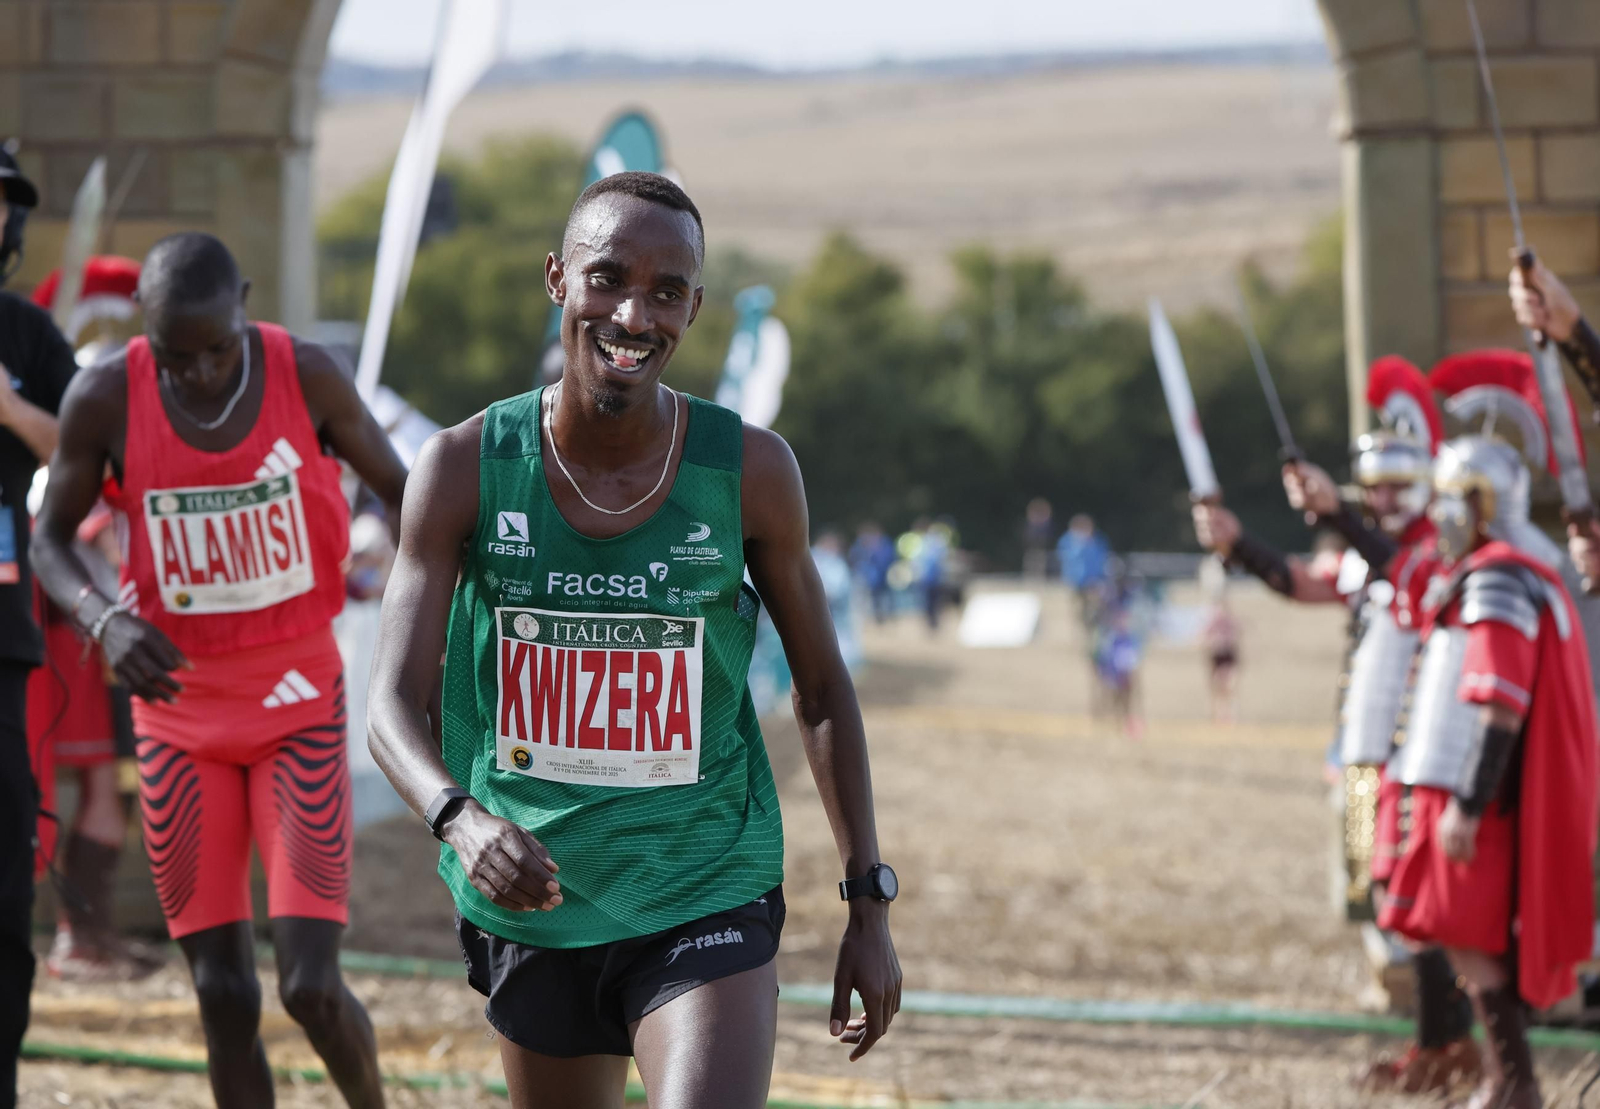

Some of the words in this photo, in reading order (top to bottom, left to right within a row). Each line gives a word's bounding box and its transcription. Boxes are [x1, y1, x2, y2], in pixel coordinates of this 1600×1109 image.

[161, 499, 303, 586] ALAMISI
[488, 542, 535, 558] rasán
[670, 546, 686, 555] PLAYAS
[687, 547, 694, 555] DE
[548, 572, 648, 598] Facsa
[682, 589, 720, 598] Diputació
[581, 599, 611, 607] integral
[552, 619, 648, 643] ITÁLICA
[552, 640, 598, 648] INTERNATIONAL
[500, 639, 693, 752] KWIZERA
[546, 760, 561, 768] CROSS
[561, 763, 600, 771] INTERNACIONAL
[695, 927, 743, 949] rasán
